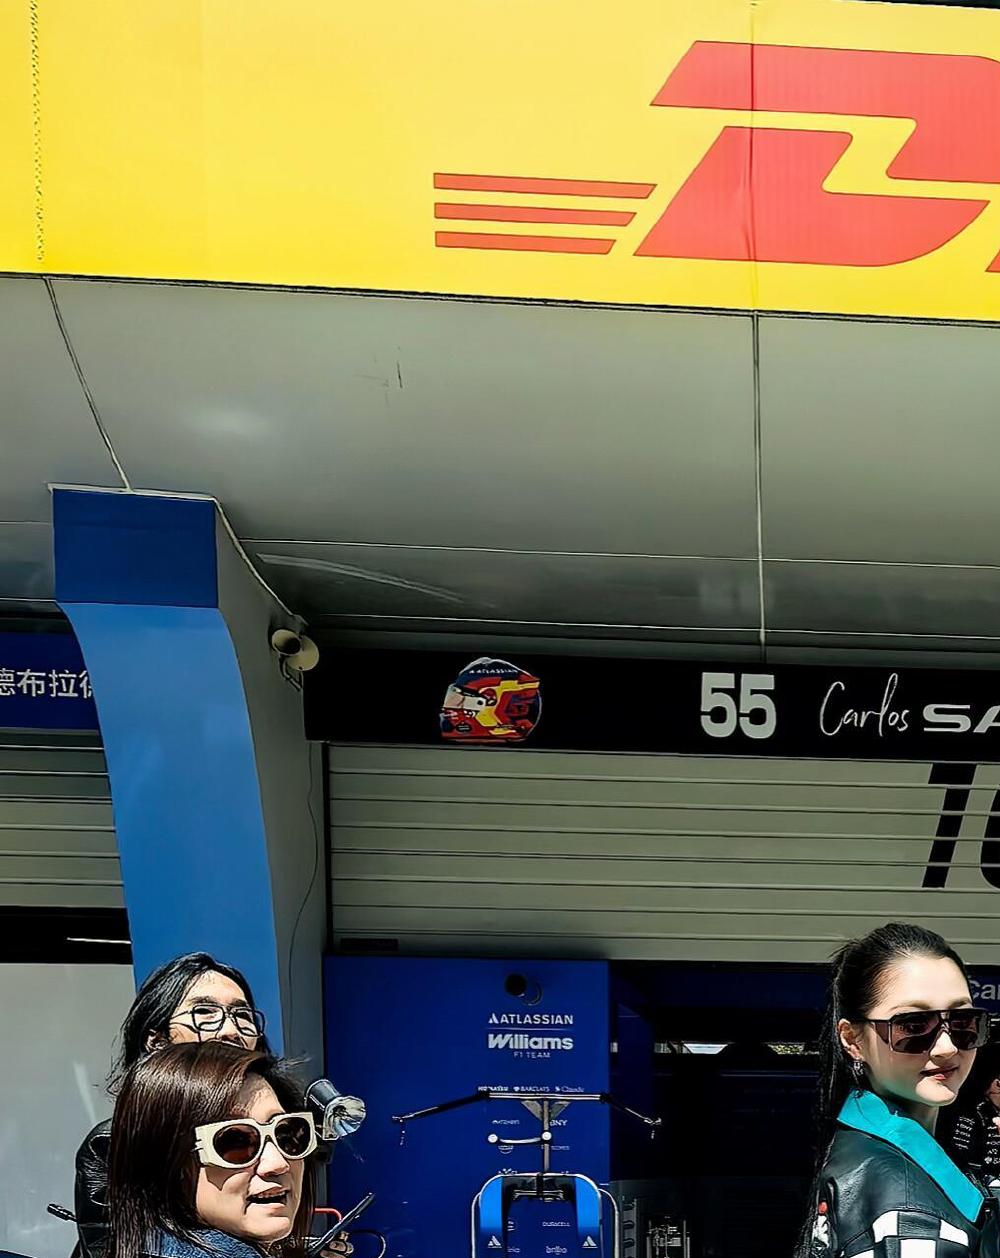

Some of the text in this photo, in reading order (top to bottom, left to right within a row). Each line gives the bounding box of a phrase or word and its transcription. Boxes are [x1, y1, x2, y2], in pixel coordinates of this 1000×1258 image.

[700, 672, 777, 739] 55
[820, 672, 909, 737] Carlos
[500, 1013, 574, 1025] ATLASSIAN
[487, 1033, 574, 1050] Williams
